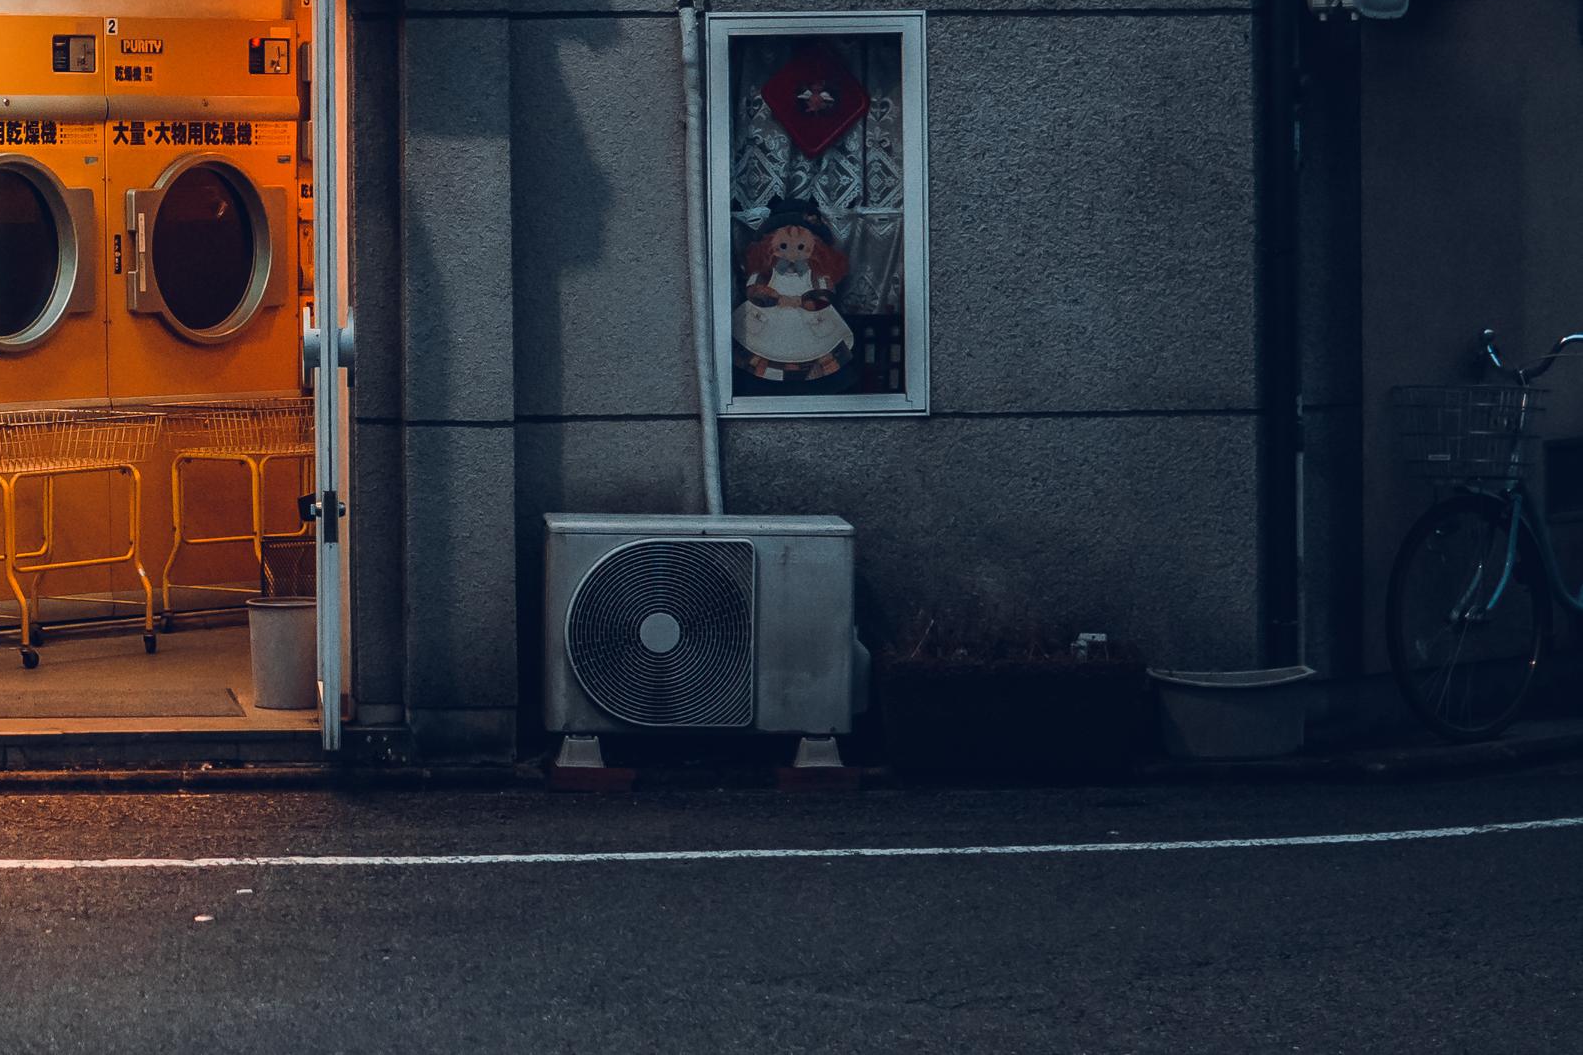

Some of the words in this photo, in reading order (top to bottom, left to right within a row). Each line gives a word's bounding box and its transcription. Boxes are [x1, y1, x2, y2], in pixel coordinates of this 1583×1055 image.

[108, 19, 116, 33] 2
[123, 39, 162, 53] PURITY
[112, 120, 253, 146] 大量・大物用乾燥機
